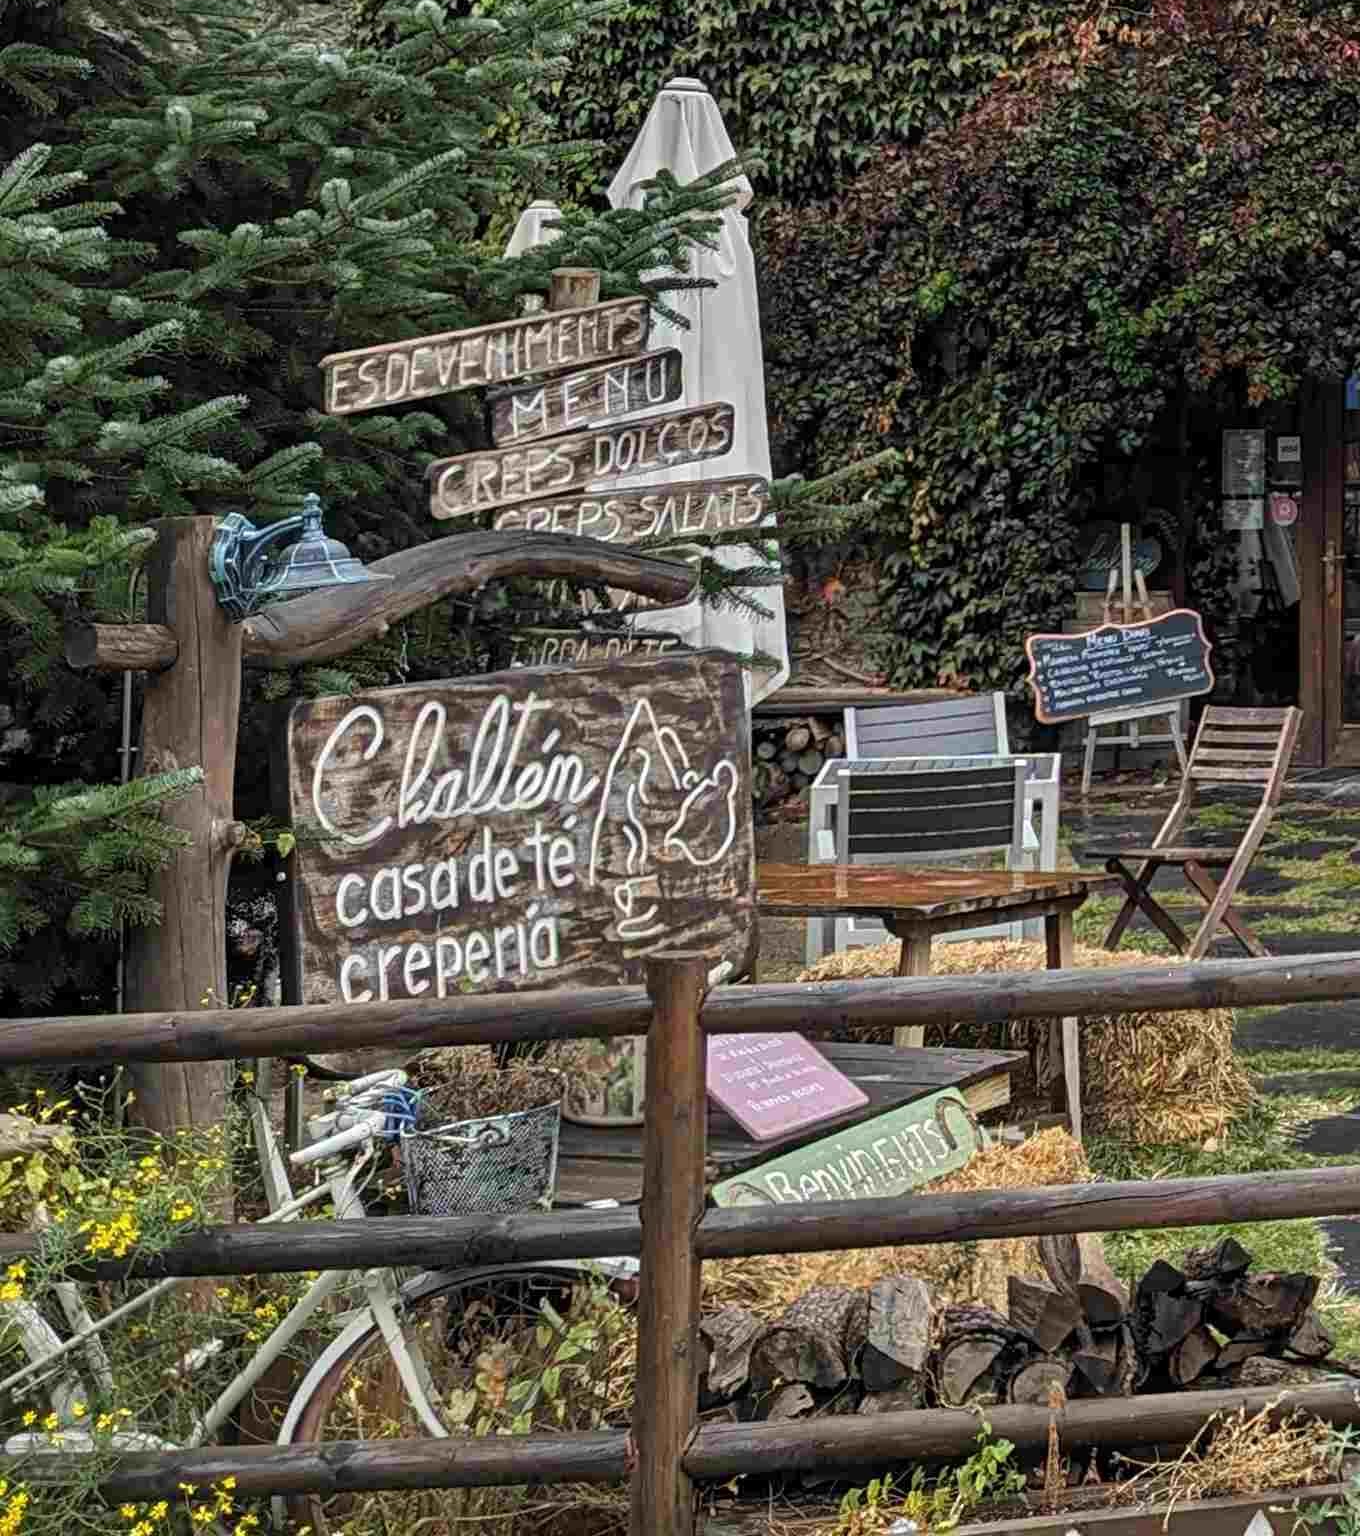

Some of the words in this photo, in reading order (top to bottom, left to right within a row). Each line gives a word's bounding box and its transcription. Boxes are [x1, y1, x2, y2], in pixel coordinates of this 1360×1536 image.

[331, 305, 646, 412] ESDEVENIMENTS
[511, 358, 667, 434] MENU
[437, 444, 575, 513] CREPS
[594, 412, 731, 477] DOLÇOS
[633, 484, 765, 537] SALATS
[312, 691, 600, 845] Chaltén
[336, 856, 459, 928] casa
[468, 826, 520, 903] de
[524, 814, 576, 890] té
